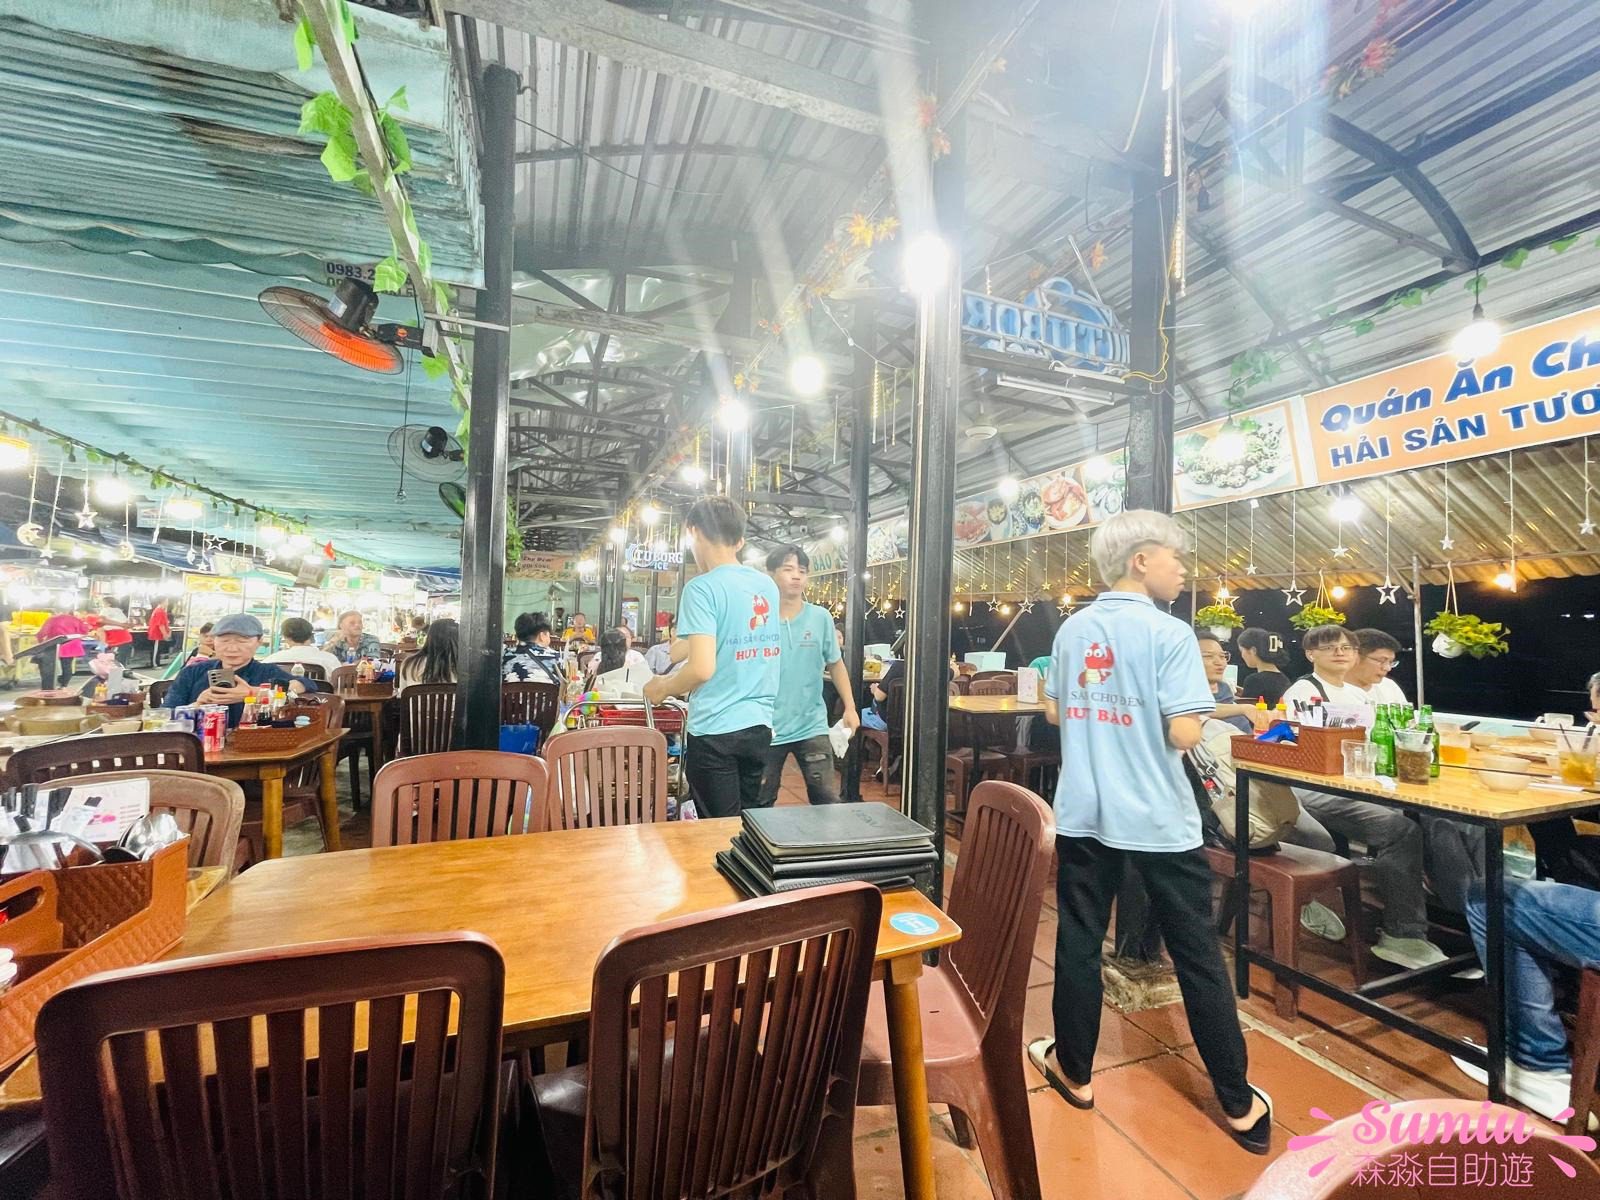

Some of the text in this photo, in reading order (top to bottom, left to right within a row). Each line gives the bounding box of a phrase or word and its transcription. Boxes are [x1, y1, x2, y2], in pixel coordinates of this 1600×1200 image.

[1320, 388, 1431, 432] Quán
[1444, 357, 1513, 403] Ăn
[1330, 434, 1390, 467] HẢI
[1404, 414, 1487, 452] SẢN
[635, 549, 683, 564] TUBORG
[653, 562, 669, 571] ICE
[735, 648, 758, 661] HUY
[1097, 707, 1133, 726] BẢO
